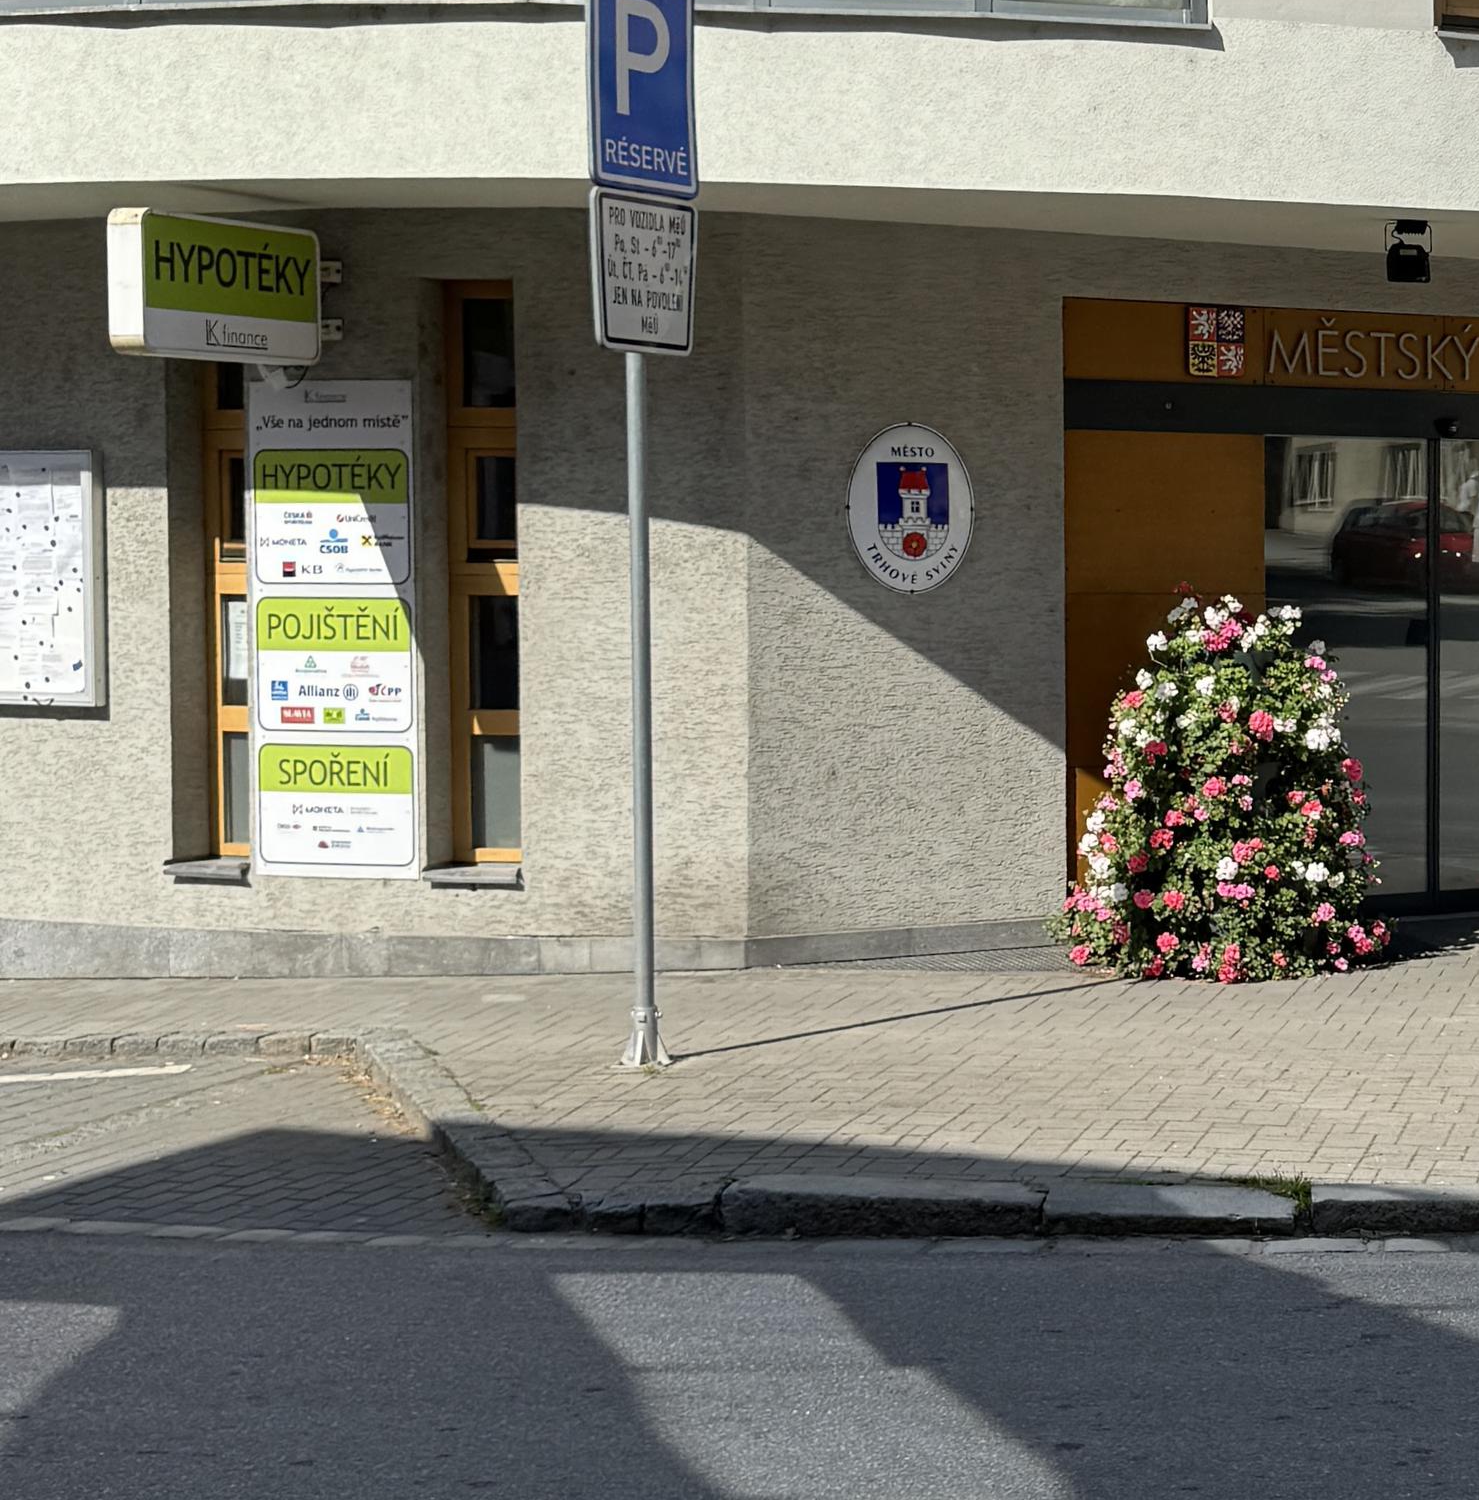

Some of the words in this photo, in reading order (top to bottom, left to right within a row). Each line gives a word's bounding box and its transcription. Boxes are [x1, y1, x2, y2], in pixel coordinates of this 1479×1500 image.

[605, 136, 688, 176] RÉSERVÉ
[609, 206, 625, 226] PRO
[630, 210, 664, 231] VOZIDLA
[631, 236, 640, 255] St
[154, 240, 311, 296] HYPOTÉKY
[612, 286, 627, 305] JEN
[632, 289, 643, 307] NA
[222, 327, 268, 349] finance
[288, 417, 303, 429] na
[307, 415, 358, 431] jednom
[891, 444, 935, 458] MĚSTO
[262, 455, 402, 490] HYPOTÉKY
[272, 538, 307, 546] MONETA
[301, 564, 323, 575] KB
[866, 542, 917, 584] TRHOVÉ
[925, 545, 958, 581] SVINY
[267, 606, 399, 641] POJIŠTĚNÍ
[298, 684, 340, 697] Allianz
[279, 752, 389, 787] SPOŘENÍ
